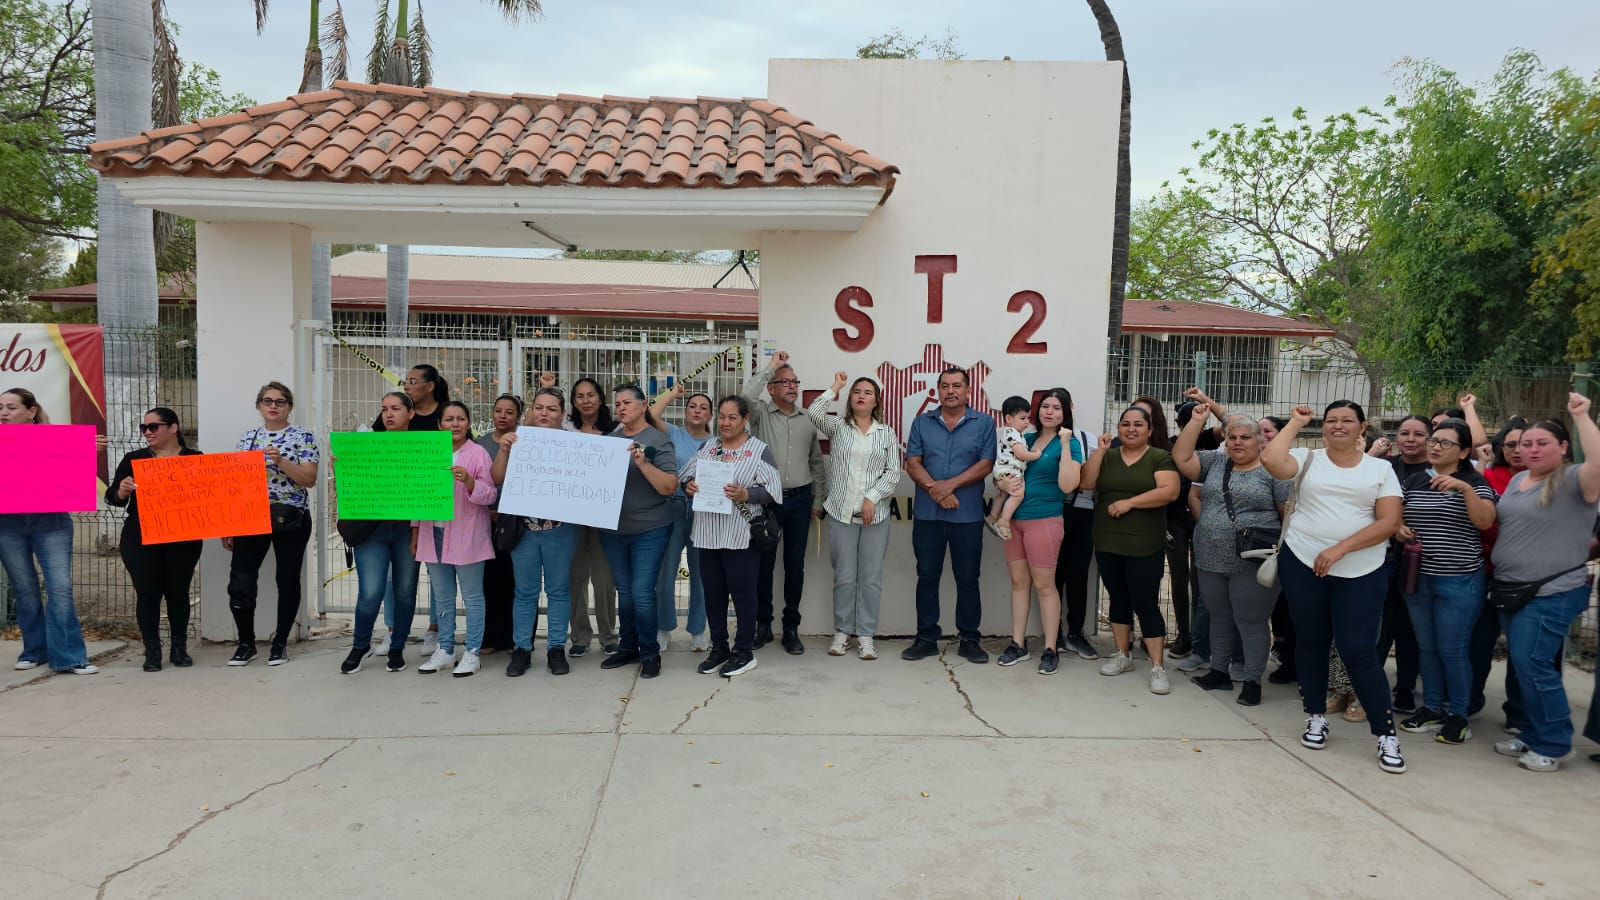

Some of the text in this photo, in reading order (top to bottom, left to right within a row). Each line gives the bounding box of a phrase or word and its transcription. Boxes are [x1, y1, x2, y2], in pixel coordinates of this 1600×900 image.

[832, 285, 874, 352] S
[914, 254, 957, 323] T
[1006, 289, 1047, 354] 2
